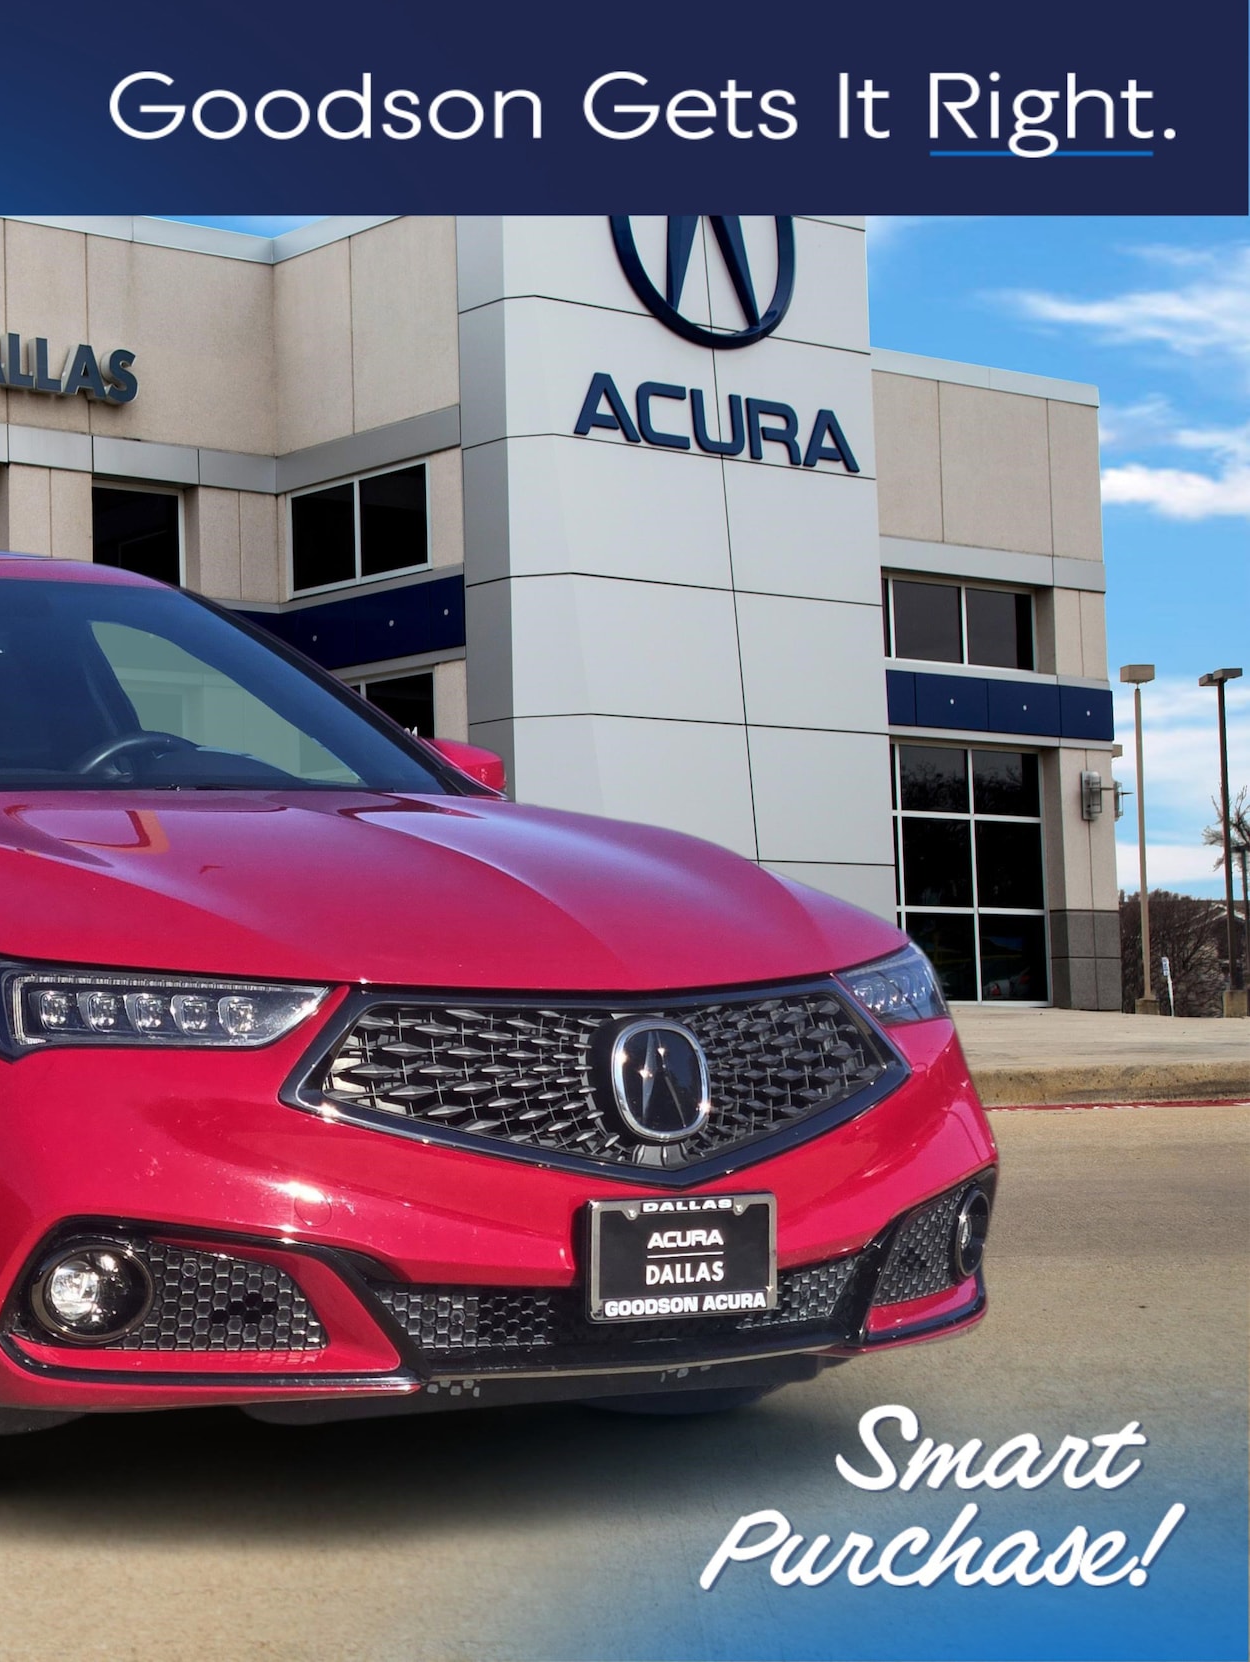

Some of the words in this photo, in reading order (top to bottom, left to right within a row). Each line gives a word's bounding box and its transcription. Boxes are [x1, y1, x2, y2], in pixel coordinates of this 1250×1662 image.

[573, 371, 860, 473] ACURA
[642, 1198, 733, 1213] DALLAS
[647, 1228, 724, 1249] ACURA
[645, 1260, 725, 1286] DALLAS
[604, 1296, 699, 1318] GOODSON
[702, 1291, 767, 1313] ACURA
